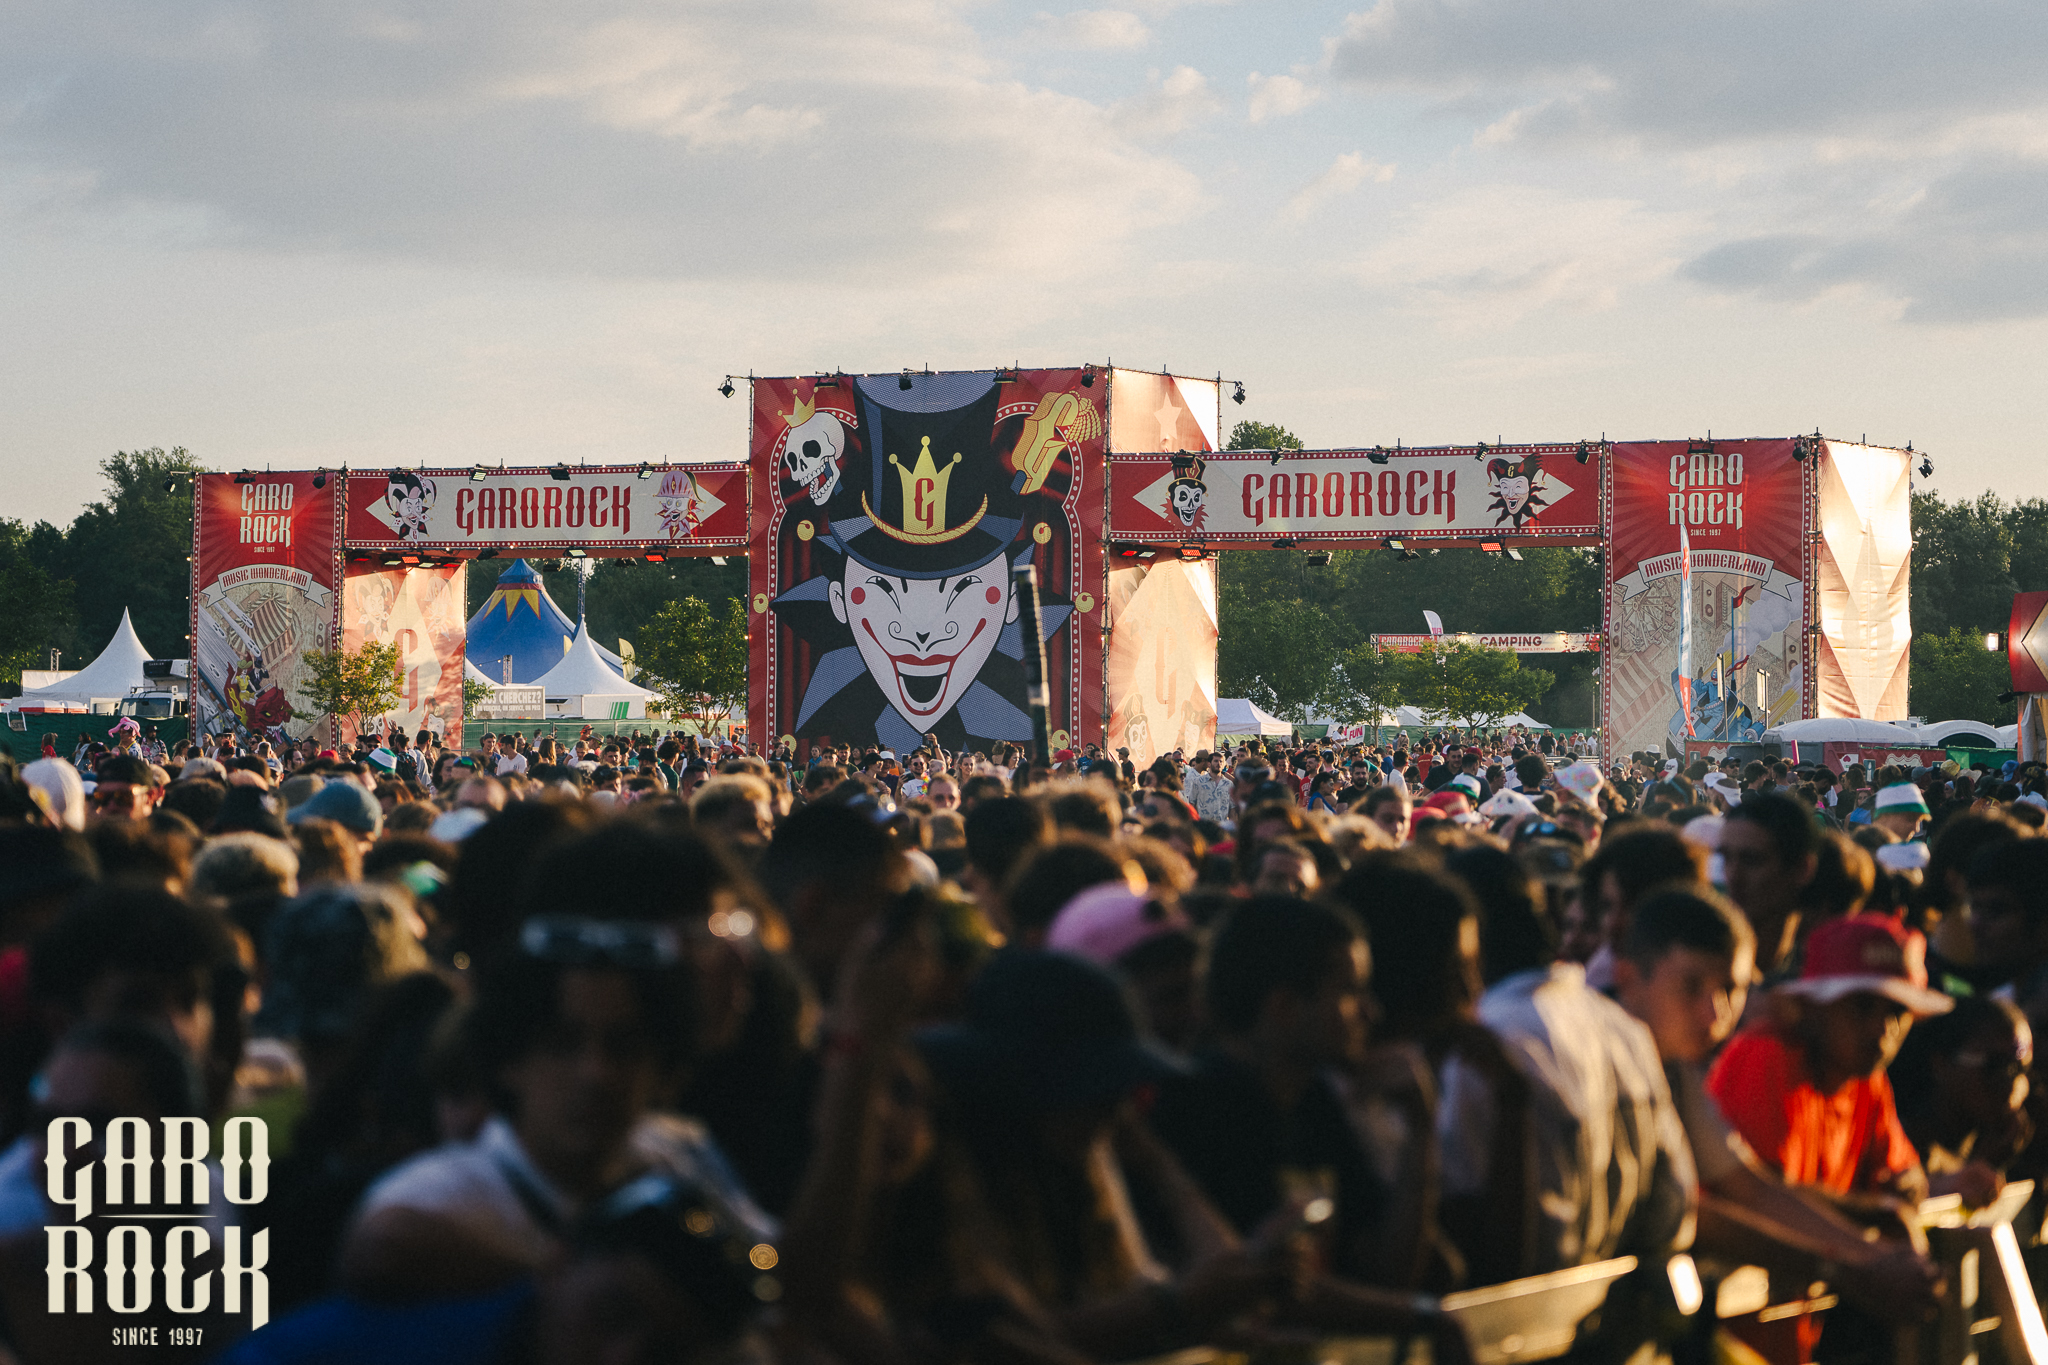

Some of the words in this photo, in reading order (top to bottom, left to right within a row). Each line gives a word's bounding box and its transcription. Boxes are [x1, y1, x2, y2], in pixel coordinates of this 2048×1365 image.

[1669, 454, 1744, 492] GARO
[241, 483, 294, 516] GARO
[455, 486, 631, 537] GAROROCK
[914, 478, 935, 531] G
[1242, 469, 1456, 527] GAROROCK
[1668, 492, 1743, 530] ROCK
[239, 516, 291, 548] ROCK
[1690, 528, 1706, 536] SINCE
[222, 569, 249, 588] MUSIC
[250, 567, 308, 587] WONDERLAND
[1644, 557, 1682, 578] MUSIC
[1480, 636, 1542, 647] CAMPING
[480, 691, 497, 704] OUS
[499, 691, 542, 704] CHERCHEZ?
[1349, 726, 1363, 740] FUN
